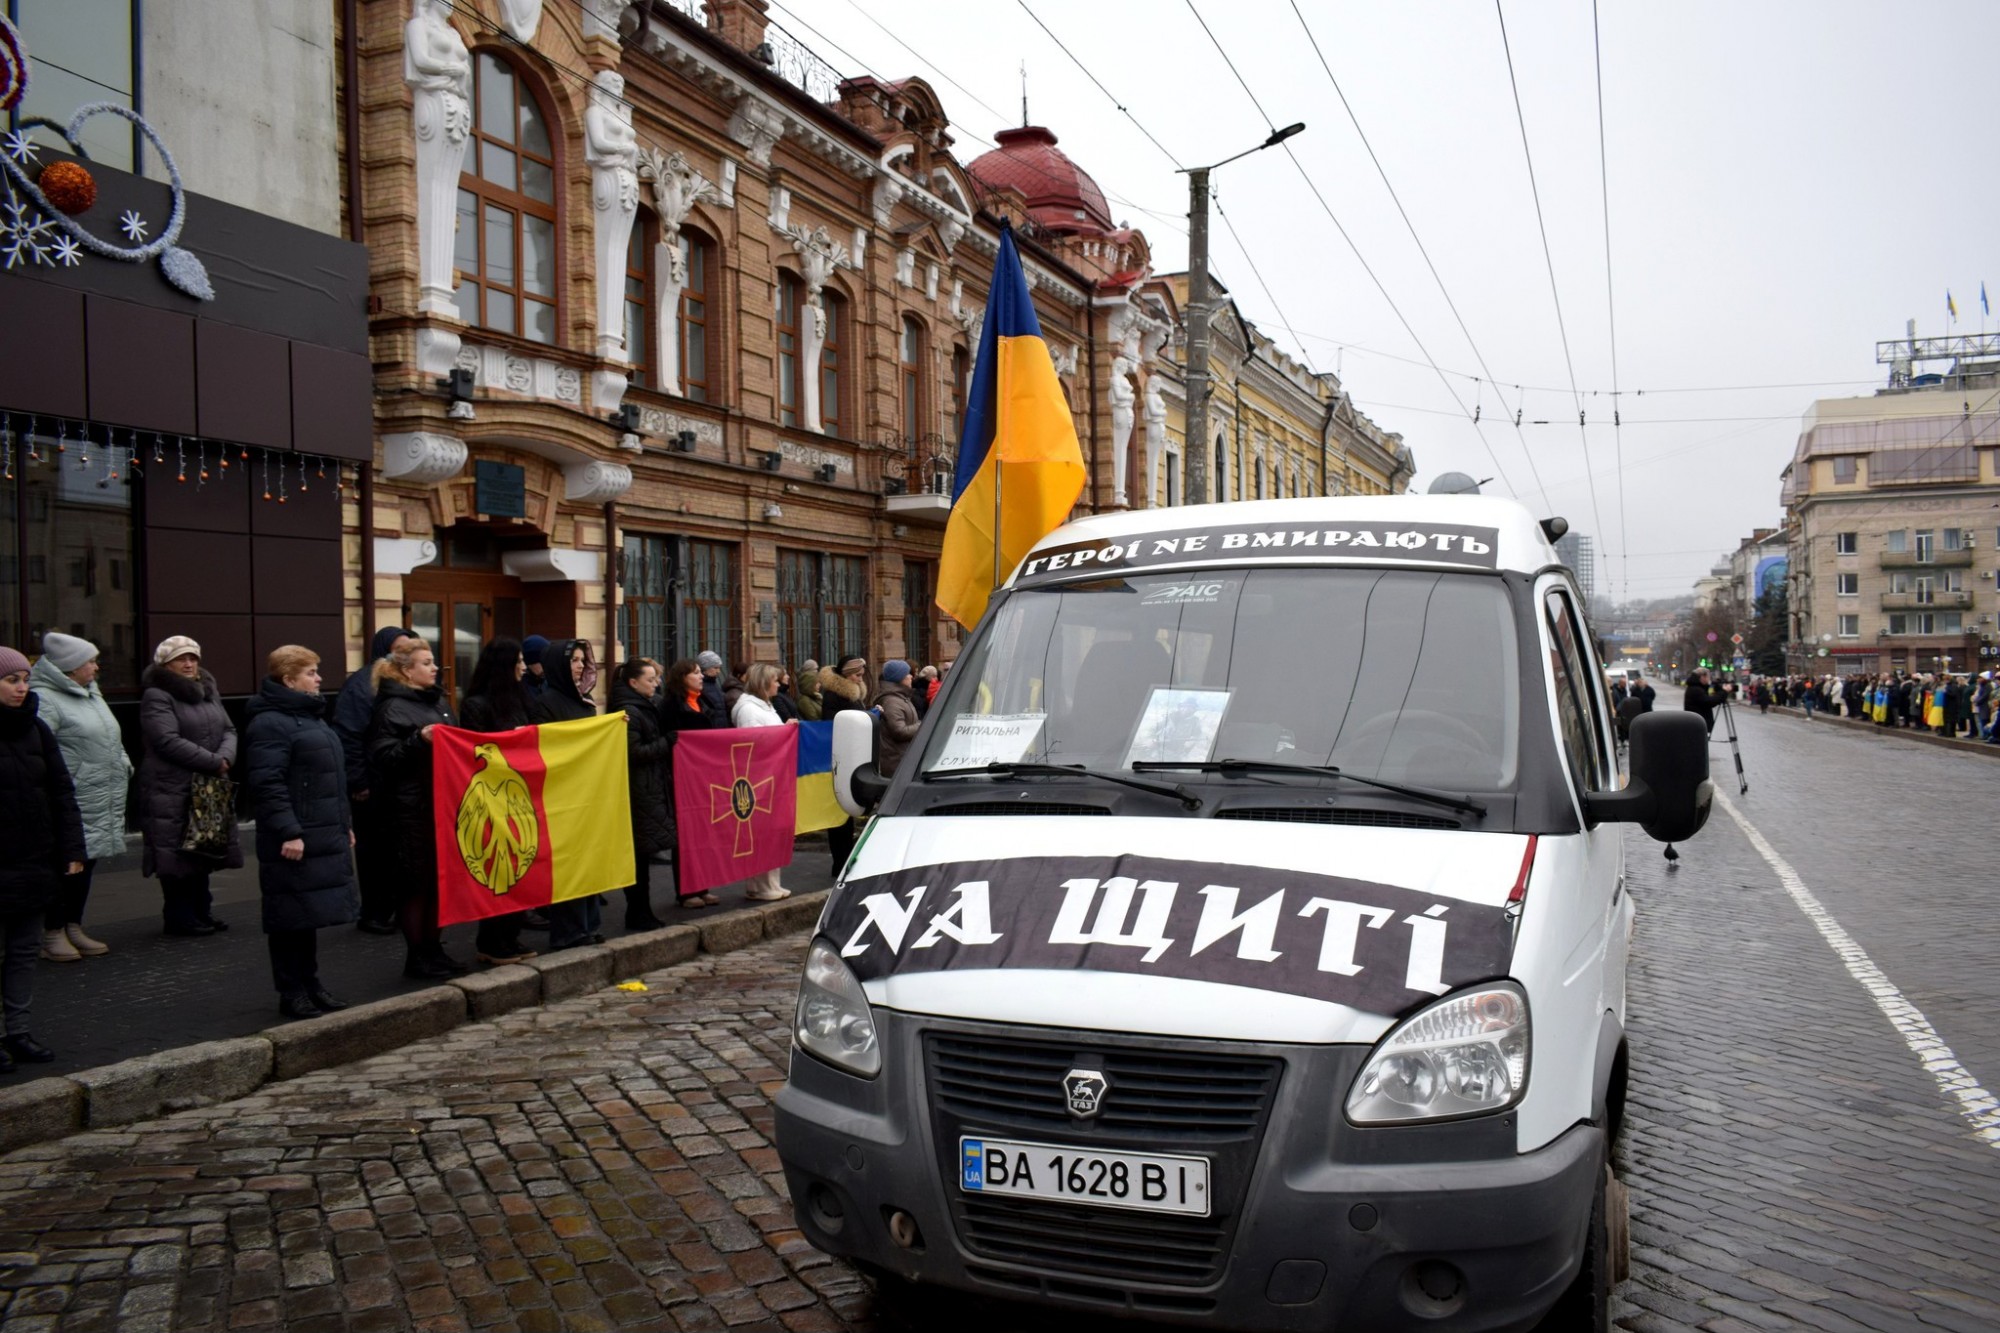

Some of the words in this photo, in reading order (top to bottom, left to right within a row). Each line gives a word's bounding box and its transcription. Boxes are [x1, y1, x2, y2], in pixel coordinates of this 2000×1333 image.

[1221, 530, 1490, 555] ВМИРАЮТЬ
[1178, 584, 1222, 597] AIC
[955, 725, 1021, 736] РИТУАЛЬНА
[965, 1170, 981, 1183] UA
[985, 1148, 1035, 1190] BA
[1048, 1155, 1130, 1198] 1628
